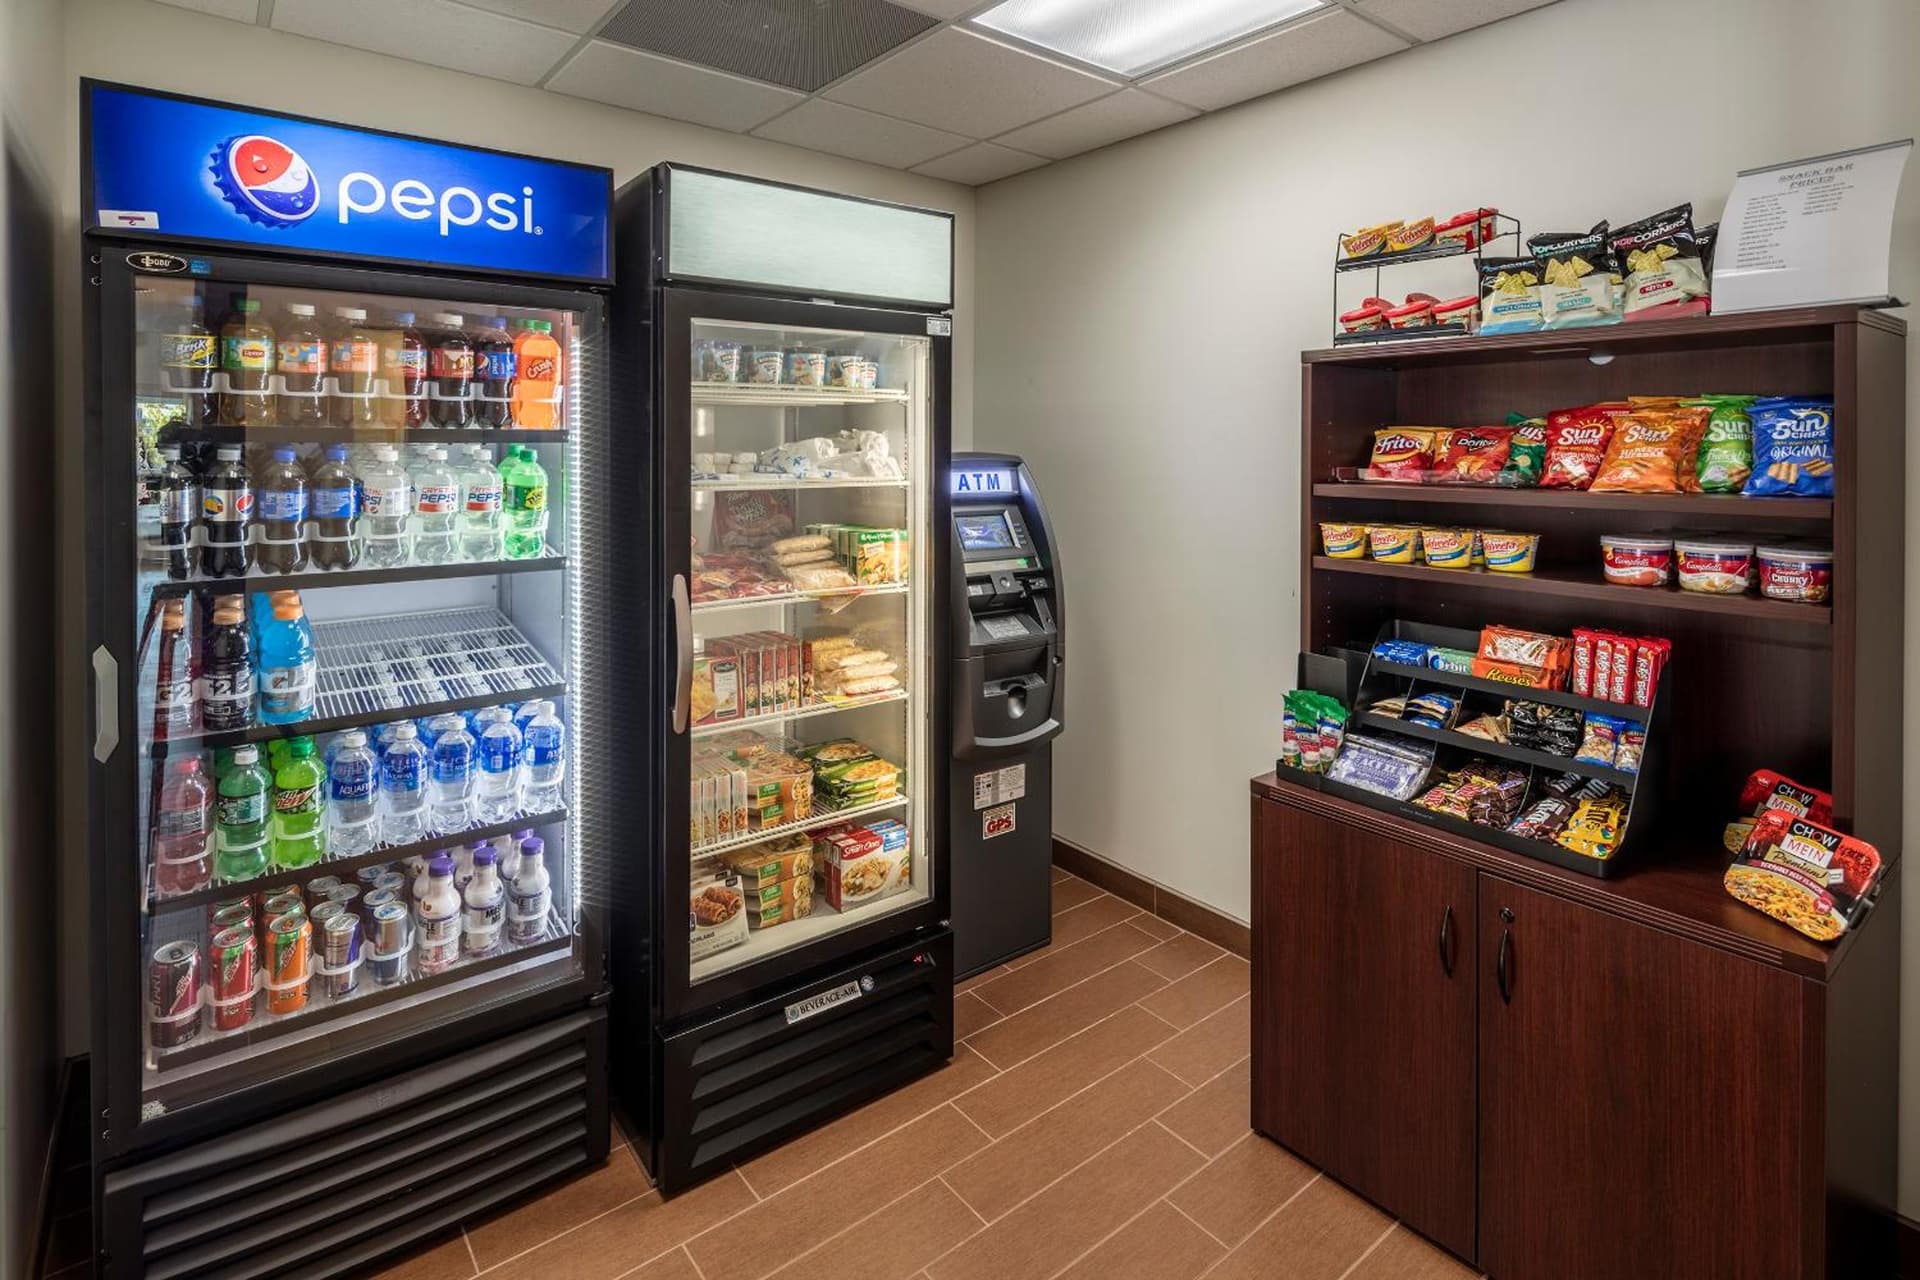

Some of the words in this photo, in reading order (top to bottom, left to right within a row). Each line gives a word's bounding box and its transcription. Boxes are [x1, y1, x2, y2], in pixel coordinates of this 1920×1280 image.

[338, 172, 532, 235] pepsi
[1375, 435, 1423, 455] Fritos
[958, 473, 1001, 491] ATM
[468, 492, 501, 502] PEPS
[1778, 784, 1814, 805] CHOW
[1771, 798, 1802, 816] MEIN
[986, 815, 1012, 833] GPS
[1793, 823, 1839, 848] CHOW
[1788, 839, 1825, 863] MEIN
[1772, 851, 1827, 879] Premium
